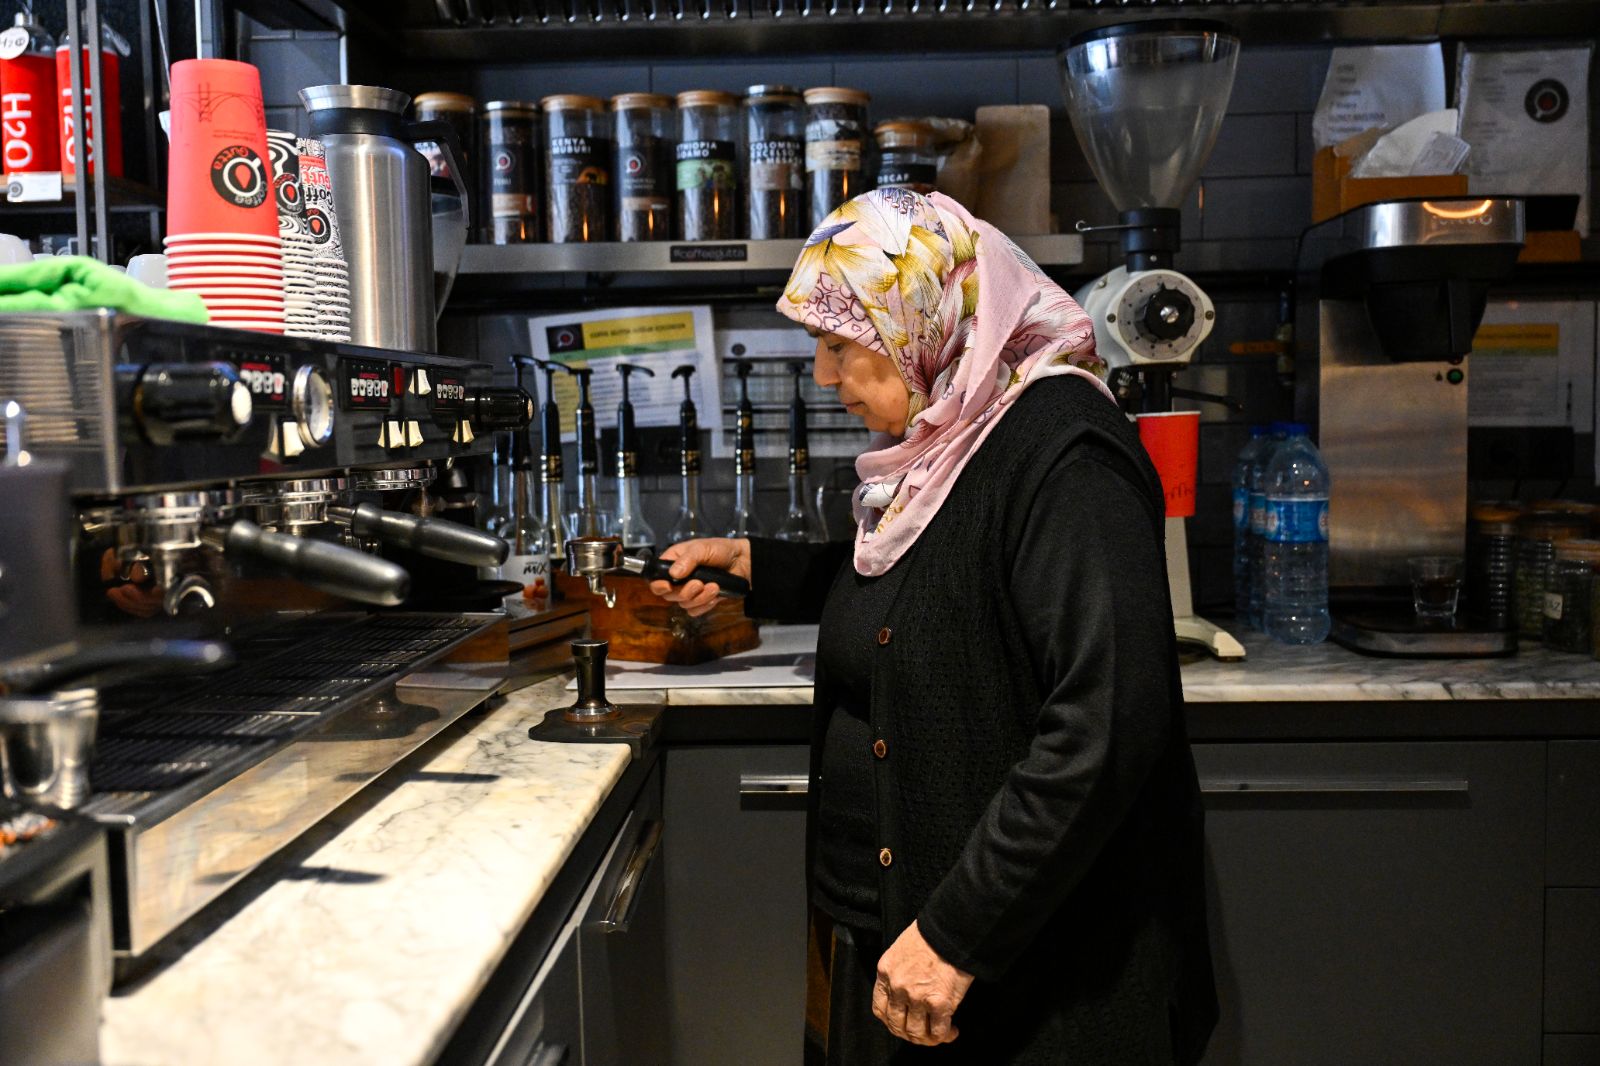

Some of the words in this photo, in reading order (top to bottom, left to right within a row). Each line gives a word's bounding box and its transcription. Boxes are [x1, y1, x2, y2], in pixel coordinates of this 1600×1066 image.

[2, 93, 32, 169] H2O
[302, 171, 332, 190] Gutt
[306, 187, 333, 206] Coff
